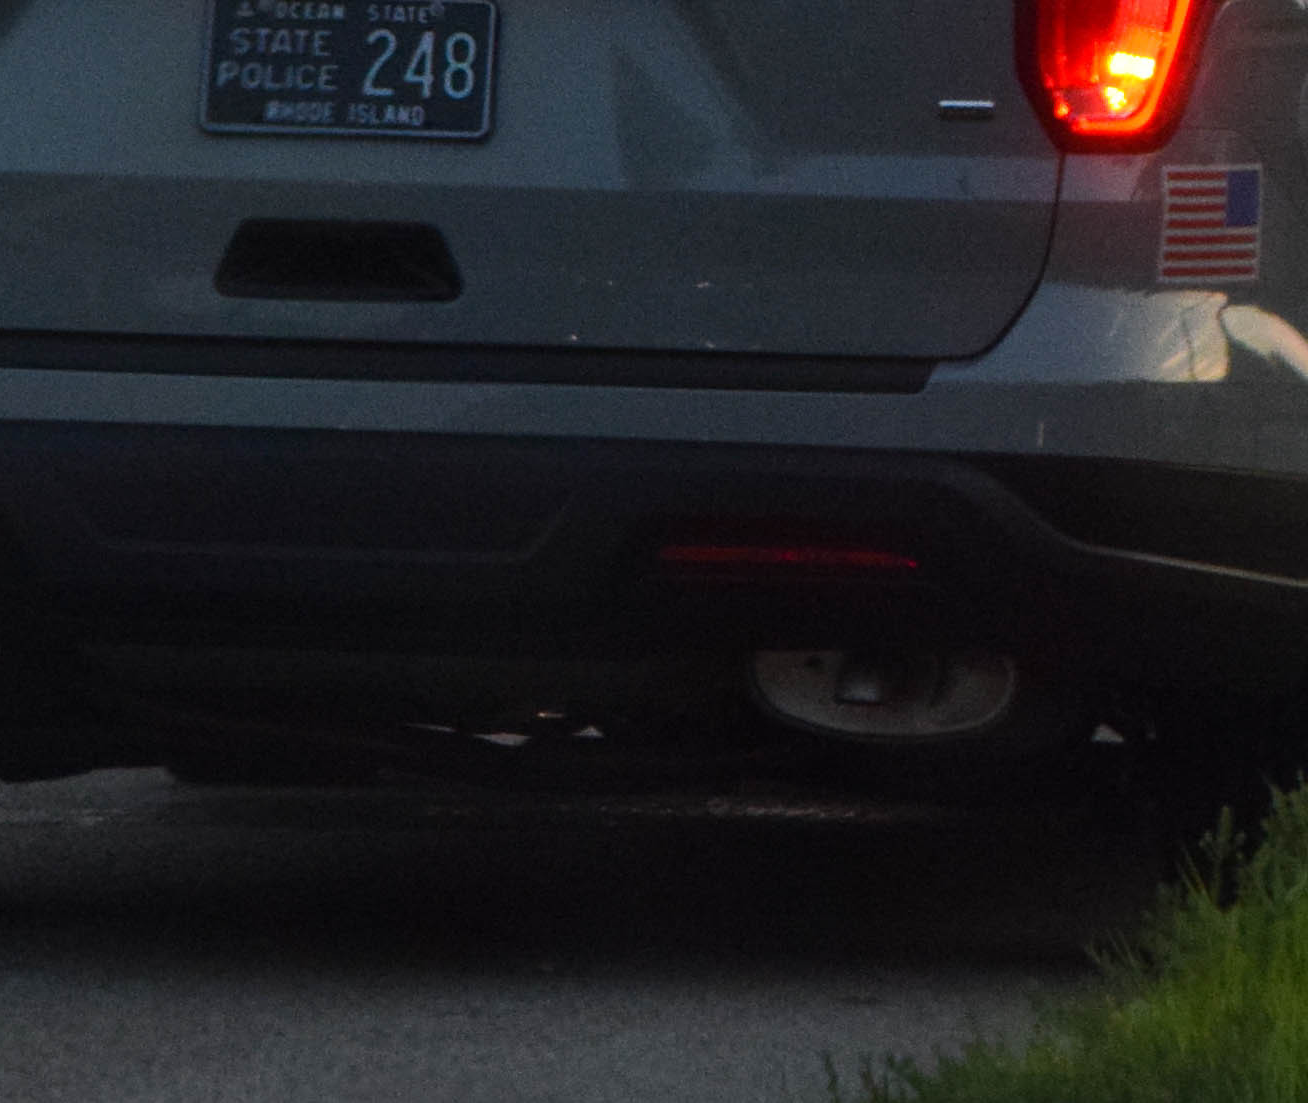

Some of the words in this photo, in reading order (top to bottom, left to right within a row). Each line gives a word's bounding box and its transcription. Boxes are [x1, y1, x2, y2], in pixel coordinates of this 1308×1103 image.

[275, 0, 347, 20] OCEAN
[367, 3, 430, 24] STATE
[229, 27, 332, 56] STATE
[215, 61, 339, 91] POLICE
[362, 28, 476, 99] 248
[263, 100, 335, 124] RHODE
[347, 102, 425, 126] ISLAND
